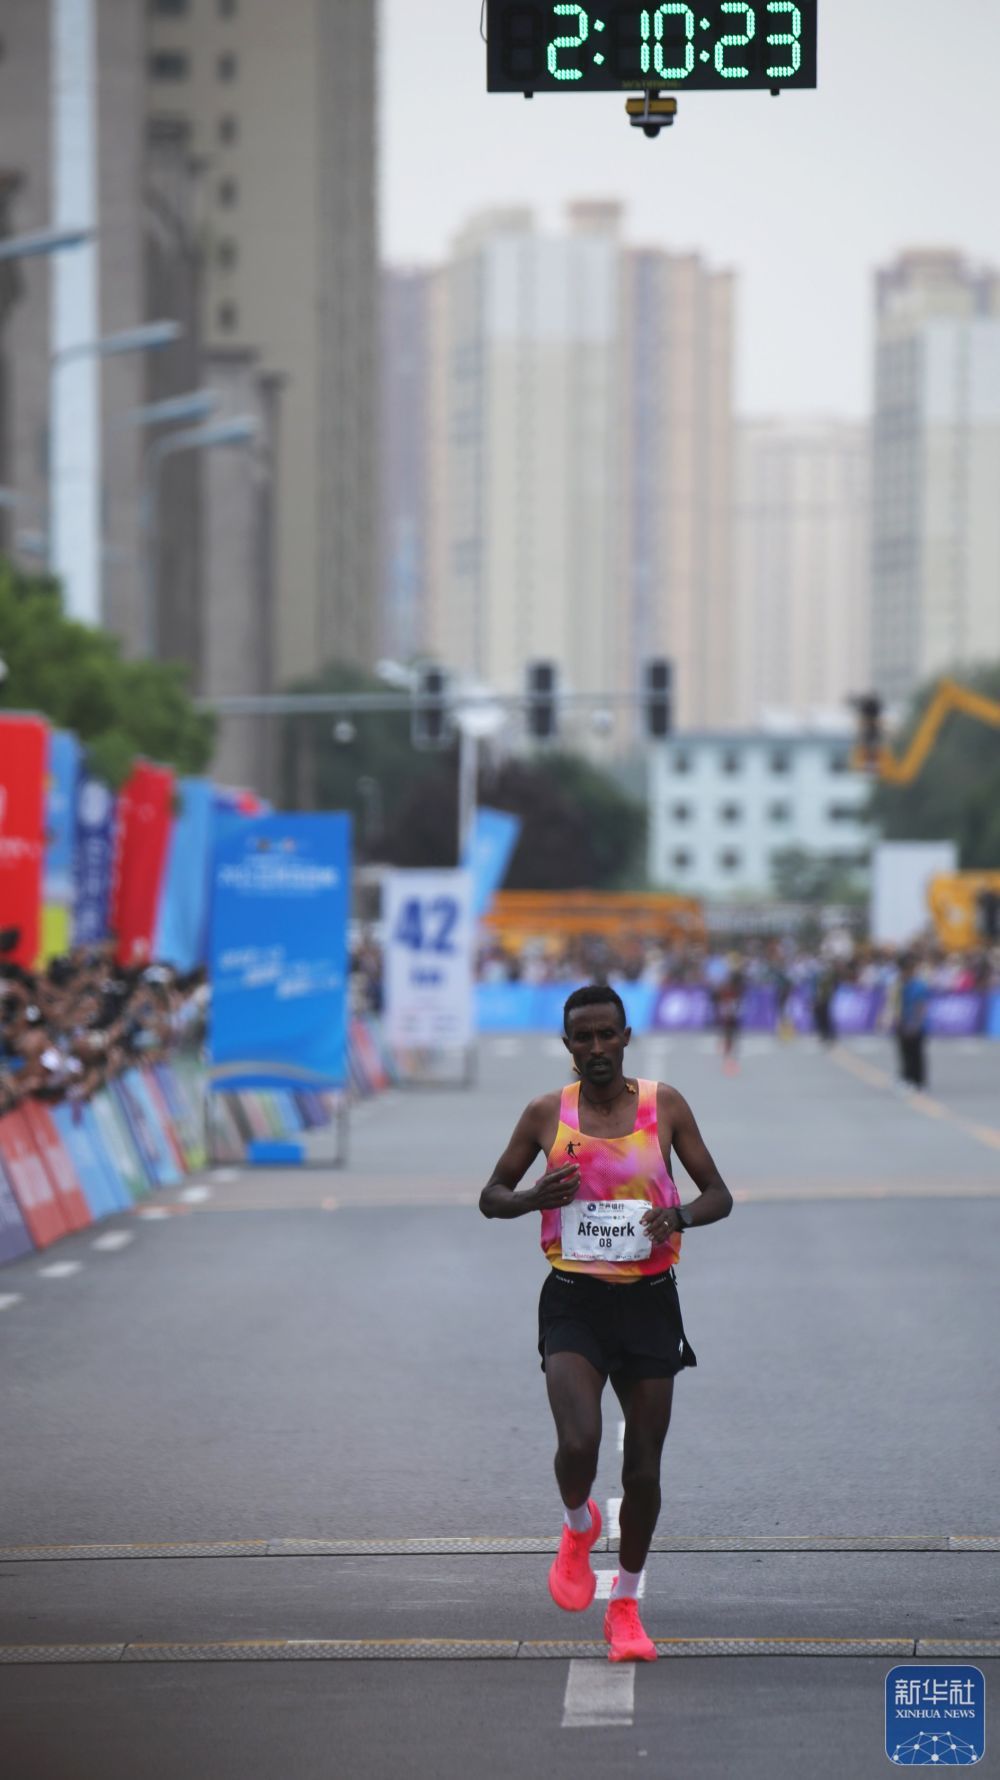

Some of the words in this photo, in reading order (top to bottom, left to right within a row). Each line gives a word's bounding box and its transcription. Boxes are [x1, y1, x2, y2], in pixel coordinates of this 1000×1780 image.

[547, 1, 801, 81] 2:10:23
[395, 897, 459, 953] 42
[577, 1222, 635, 1237] Afewerk
[599, 1238, 612, 1248] 08
